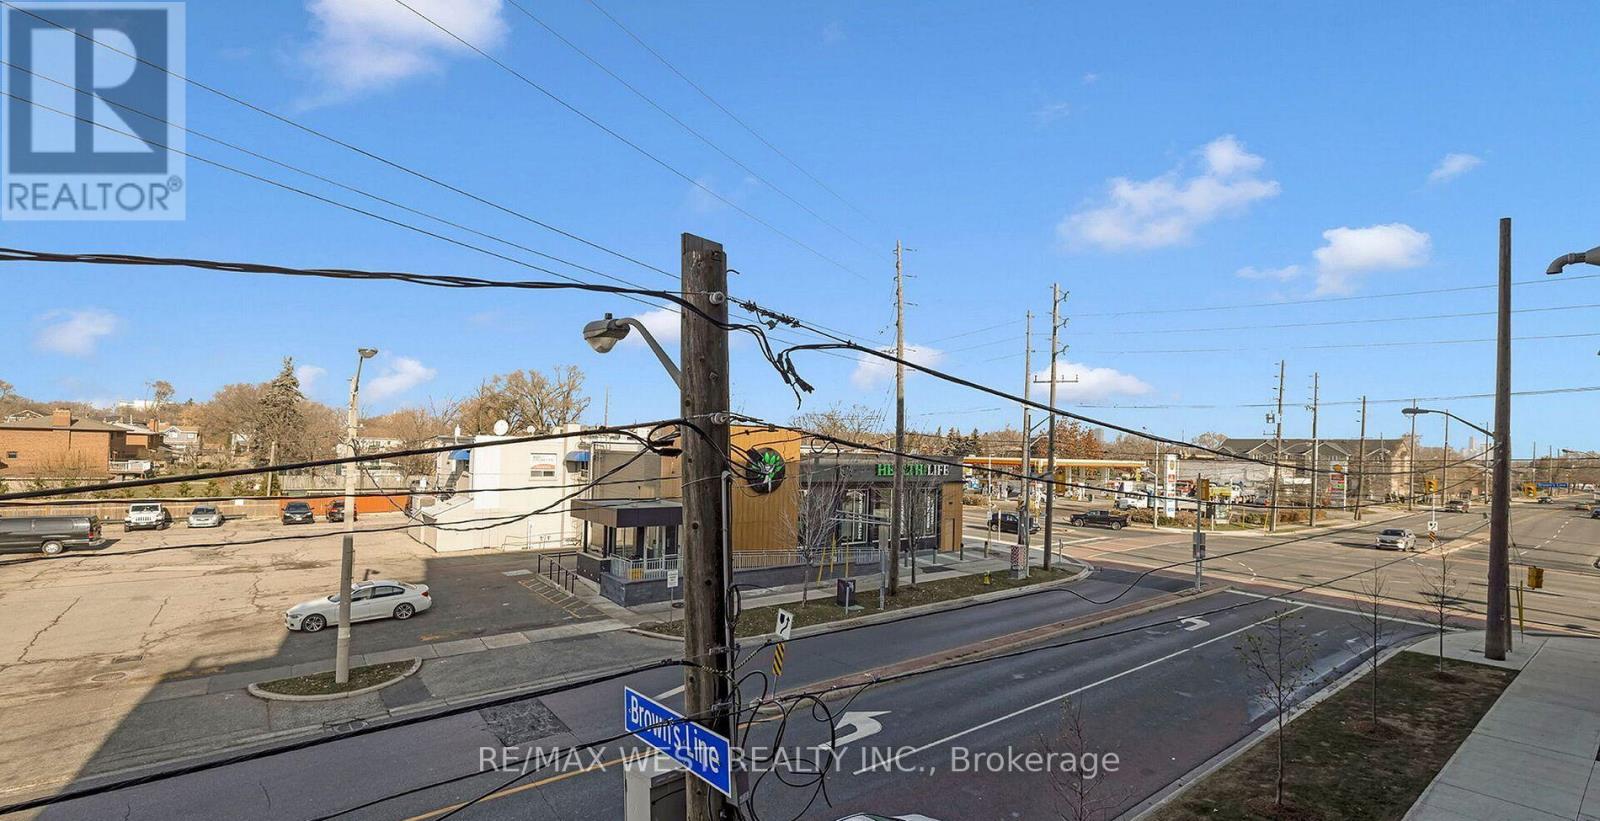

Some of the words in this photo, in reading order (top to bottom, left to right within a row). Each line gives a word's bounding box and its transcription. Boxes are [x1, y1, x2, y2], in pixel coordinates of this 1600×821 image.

[877, 463, 924, 476] HELTH
[927, 463, 949, 476] LIFE
[630, 695, 682, 749] Brown's
[686, 725, 720, 774] Line
